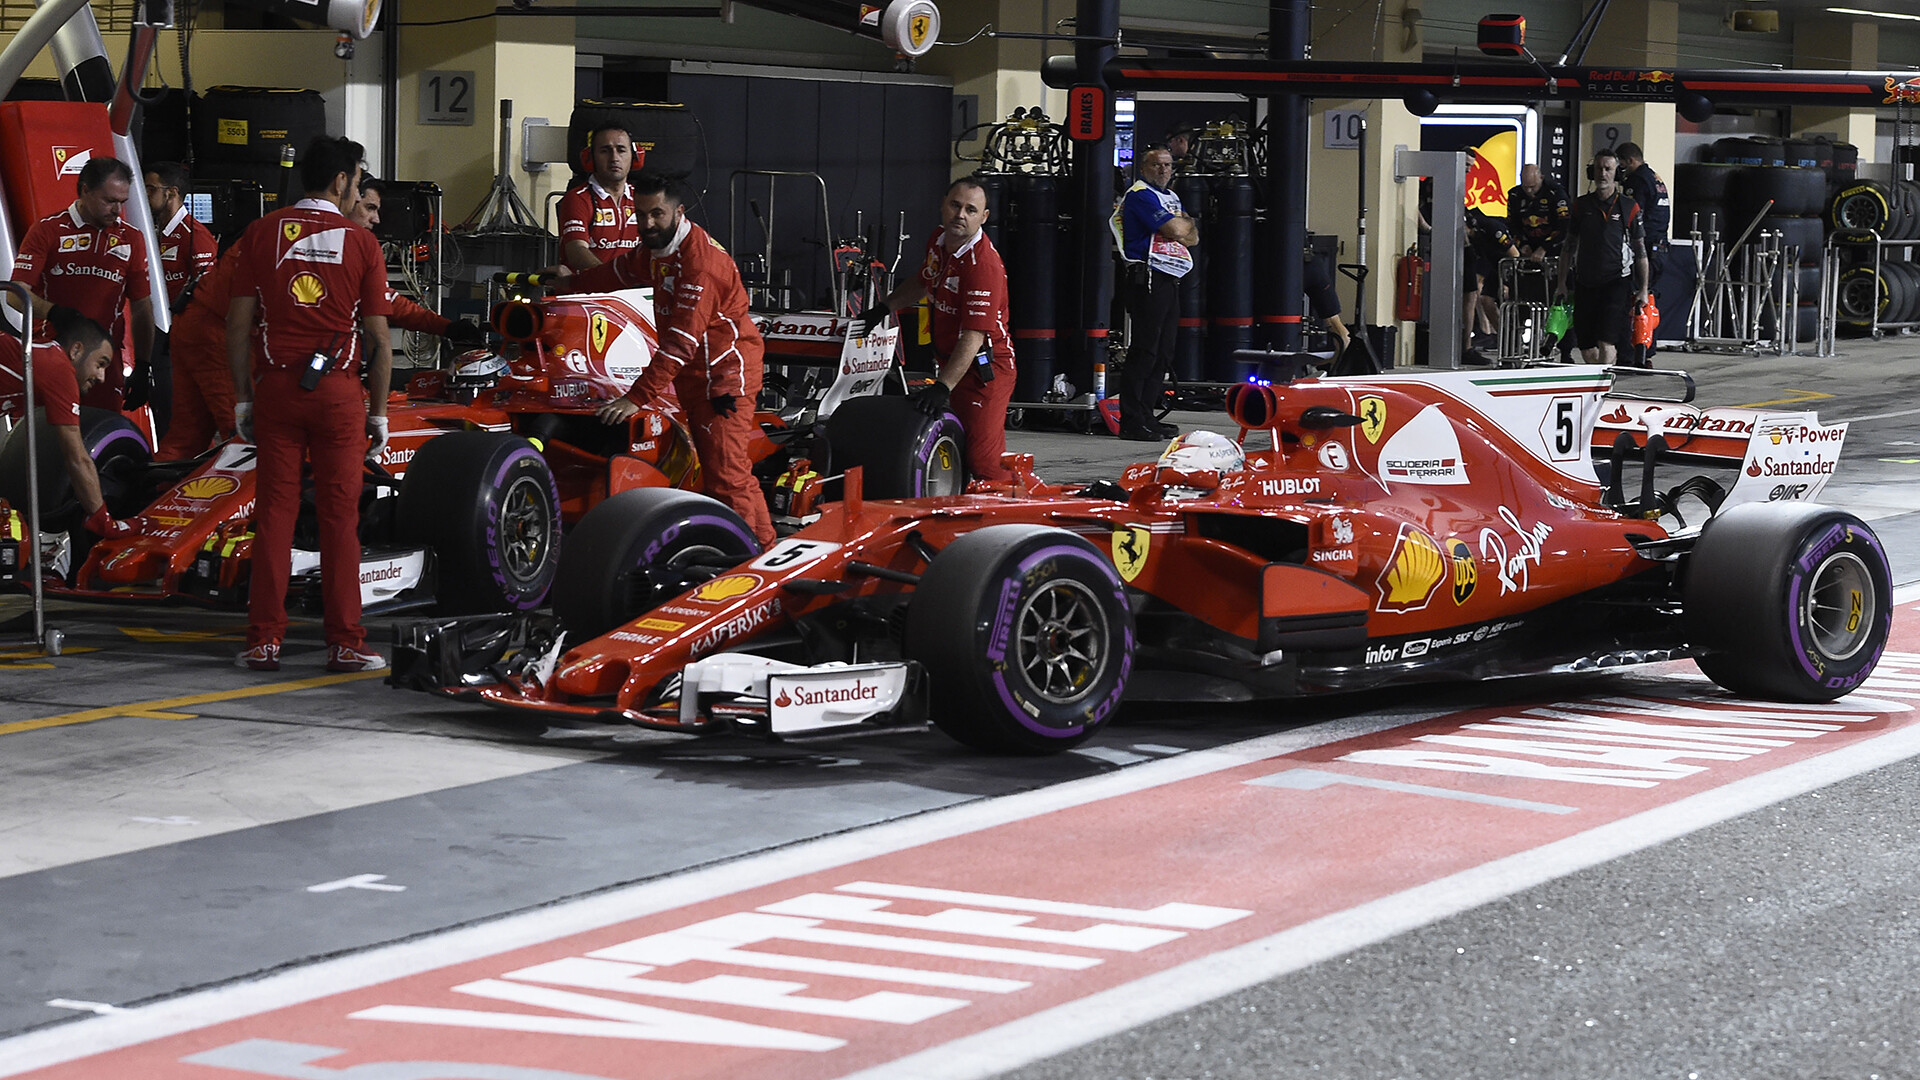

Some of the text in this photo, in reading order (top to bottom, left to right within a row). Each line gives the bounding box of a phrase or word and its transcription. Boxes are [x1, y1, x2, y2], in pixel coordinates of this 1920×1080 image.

[1589, 70, 1636, 81] Red Bull
[428, 76, 469, 112] 12
[1587, 83, 1674, 93] RACING
[1080, 92, 1094, 134] BRAKES
[226, 127, 247, 136] 5503
[1331, 113, 1361, 140] 10
[1605, 126, 1619, 150] 9
[851, 352, 891, 375] Santander
[554, 380, 590, 398] HUBLOT
[1554, 402, 1574, 454] 5
[225, 446, 257, 468] 7
[382, 445, 417, 465] Santa
[631, 441, 656, 453] SINGHA
[1386, 459, 1440, 468] SCUDERIA
[1409, 467, 1456, 477] FERRARI
[1763, 453, 1836, 477] Santander
[1262, 477, 1321, 496] HUBLOT
[763, 544, 815, 570] 5
[1312, 549, 1354, 562] SINGHA
[1800, 523, 1847, 573] PIRELLI
[359, 562, 403, 584] antander
[689, 601, 774, 656] KASPERSKY
[987, 577, 1022, 662] PIRELLI
[608, 631, 664, 645] MAHLE
[1365, 643, 1399, 664] infor
[1453, 630, 1474, 645] SKF
[794, 680, 879, 707] Santander
[347, 880, 1253, 1053] VETTEL
